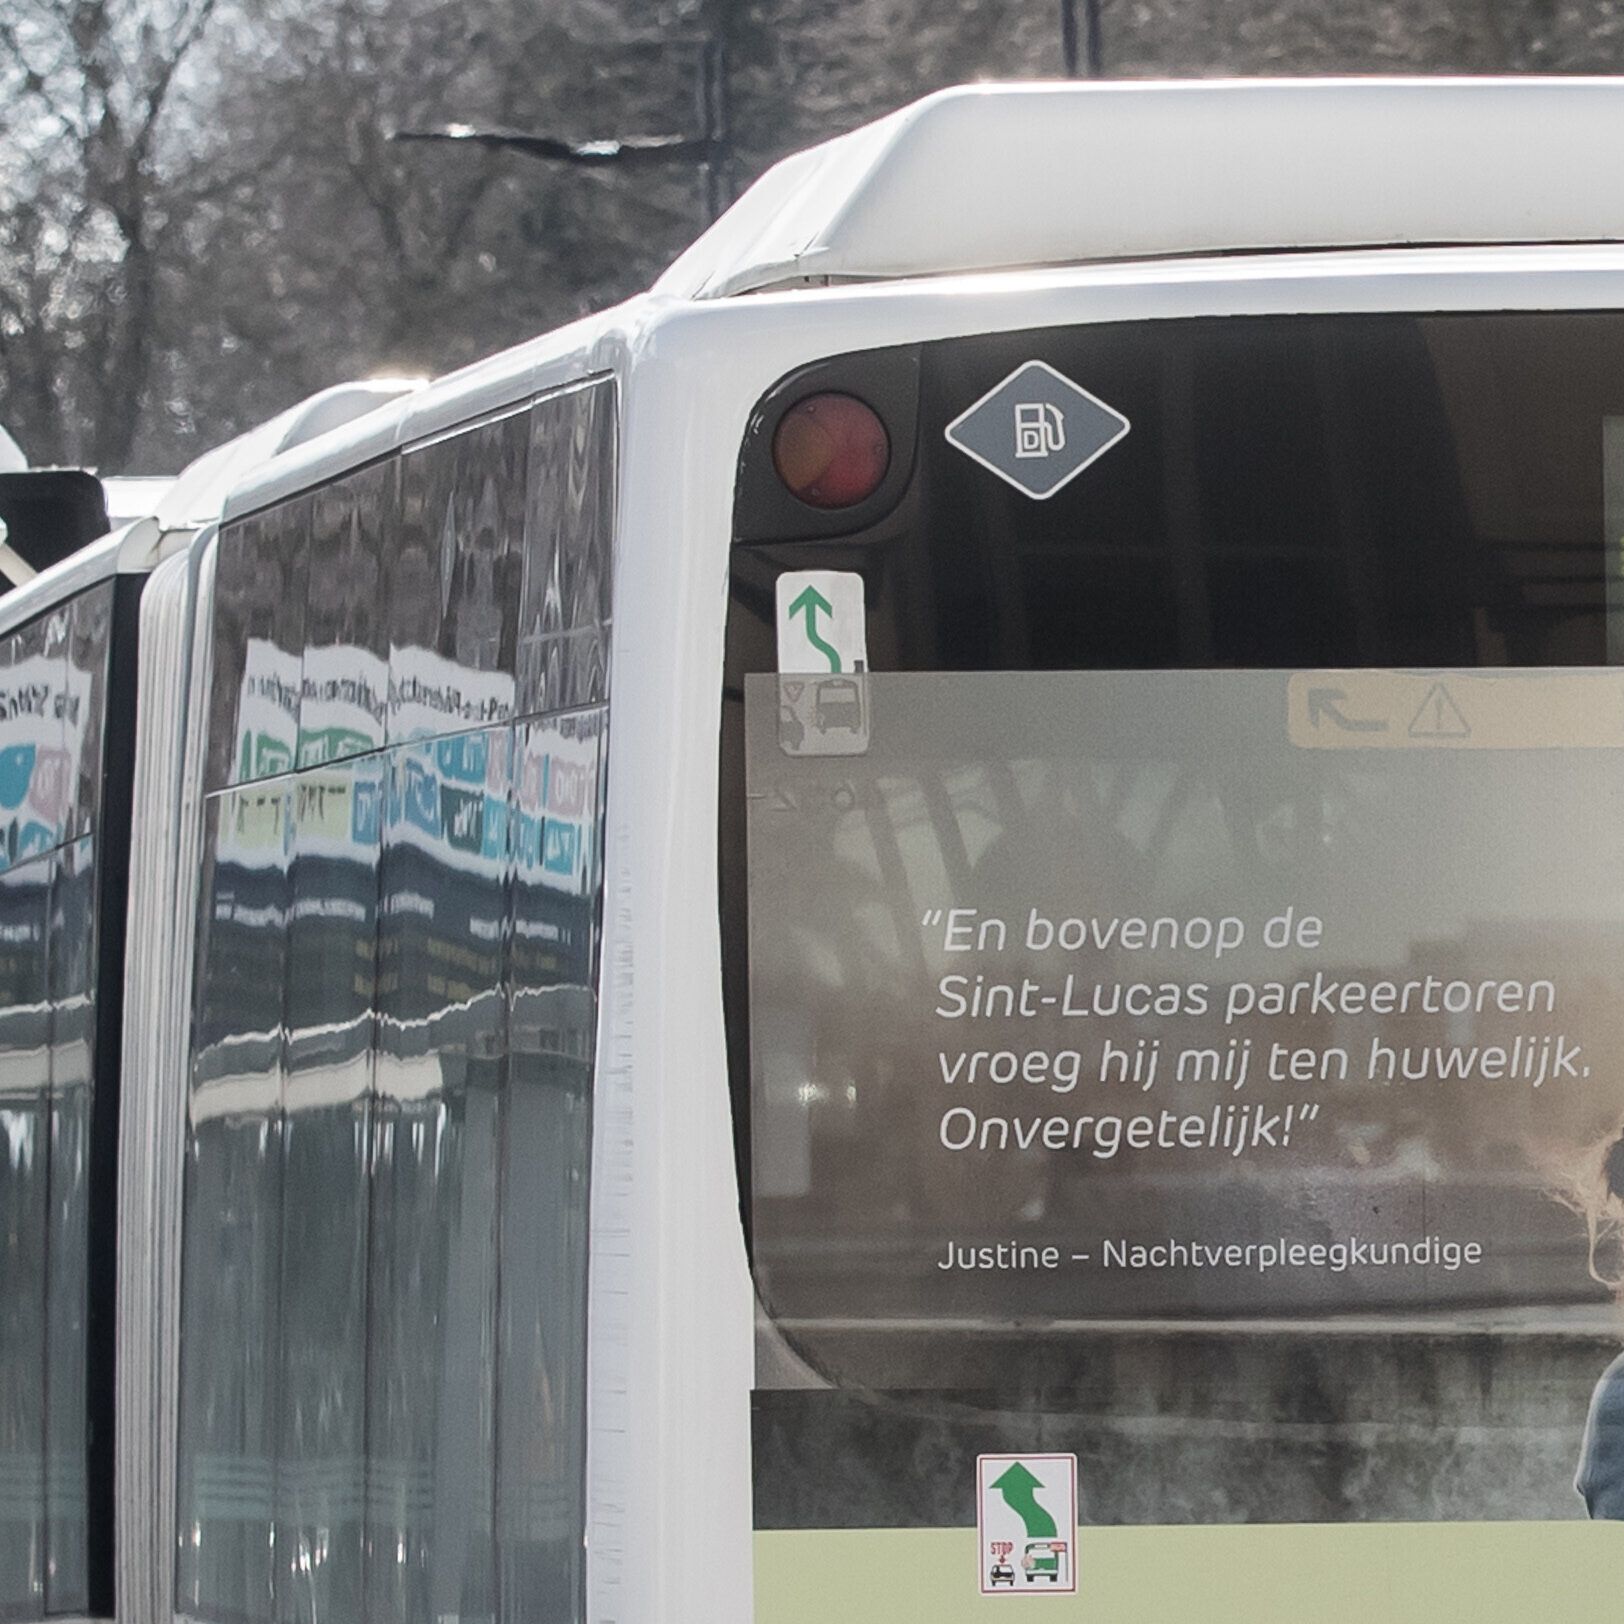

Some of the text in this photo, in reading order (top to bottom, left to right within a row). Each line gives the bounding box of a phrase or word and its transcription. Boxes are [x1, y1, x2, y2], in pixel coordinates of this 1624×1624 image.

[1026, 909, 1245, 958] bovenop
[1263, 907, 1324, 949] de
[935, 972, 1557, 1024] Sint-Lucas parkeertoren
[938, 1036, 1592, 1093] vroeg hij mij ten huwelijk.
[939, 1103, 1320, 1159] Onvergetelijk!”
[937, 1241, 1060, 1272] Justine
[1102, 1237, 1484, 1273] Nachtverpleegkundige
[990, 1541, 1014, 1555] STOP
